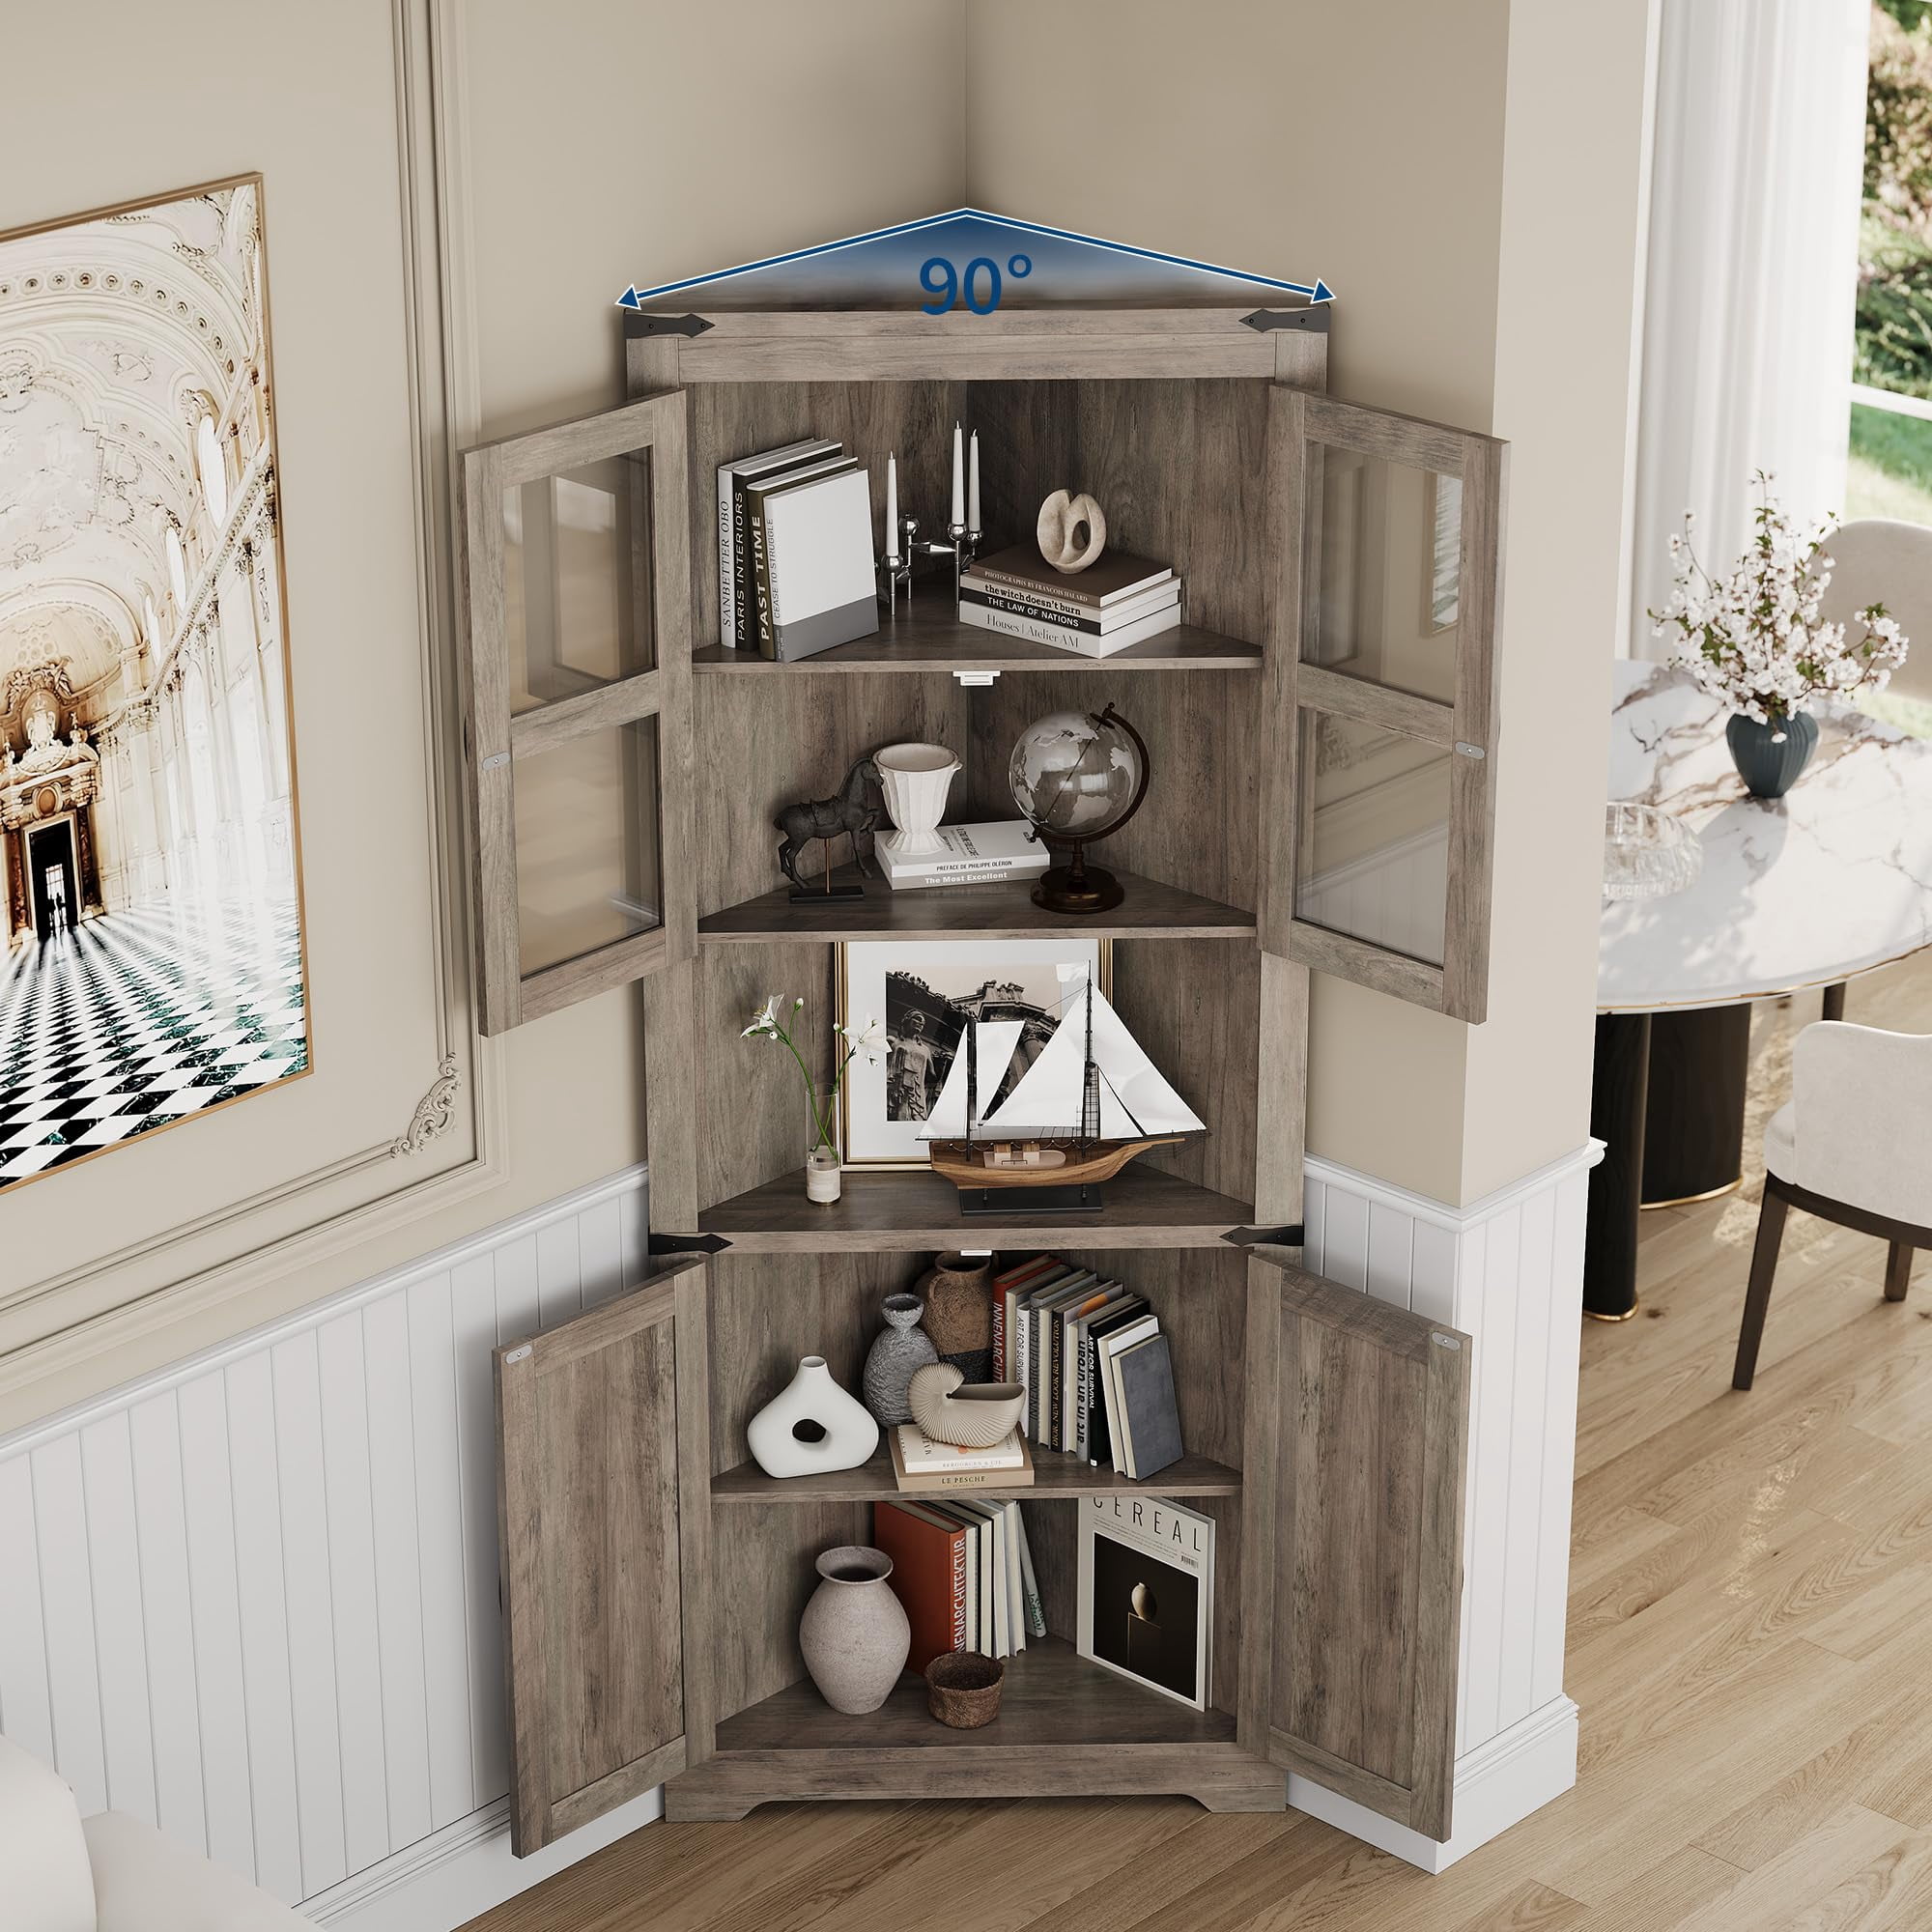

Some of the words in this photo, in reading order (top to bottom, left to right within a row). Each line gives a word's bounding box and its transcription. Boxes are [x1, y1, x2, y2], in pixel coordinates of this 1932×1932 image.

[720, 500, 729, 533] OBO
[735, 492, 744, 583] INTERIORS
[752, 516, 764, 573] TIME
[767, 518, 777, 570] STRUGGLE
[721, 539, 731, 627] SANBETTER
[770, 572, 778, 583] TO
[984, 571, 1026, 586] PHOTOGRAPHS
[736, 590, 745, 640] PARIS
[756, 582, 770, 640] PAST
[984, 583, 1000, 595] the
[1001, 588, 1025, 601] witch
[1025, 594, 1059, 611] doesn't
[1060, 602, 1081, 615] burn
[987, 597, 1005, 608] THE
[1007, 603, 1025, 612] LAW
[1027, 608, 1038, 616] OF
[1041, 611, 1079, 627] NATIONS
[986, 613, 1020, 633] Houses
[1027, 625, 1059, 642] Atelier
[1061, 635, 1079, 648] AM
[967, 872, 1008, 881] Excellent
[1076, 1385, 1086, 1403] an
